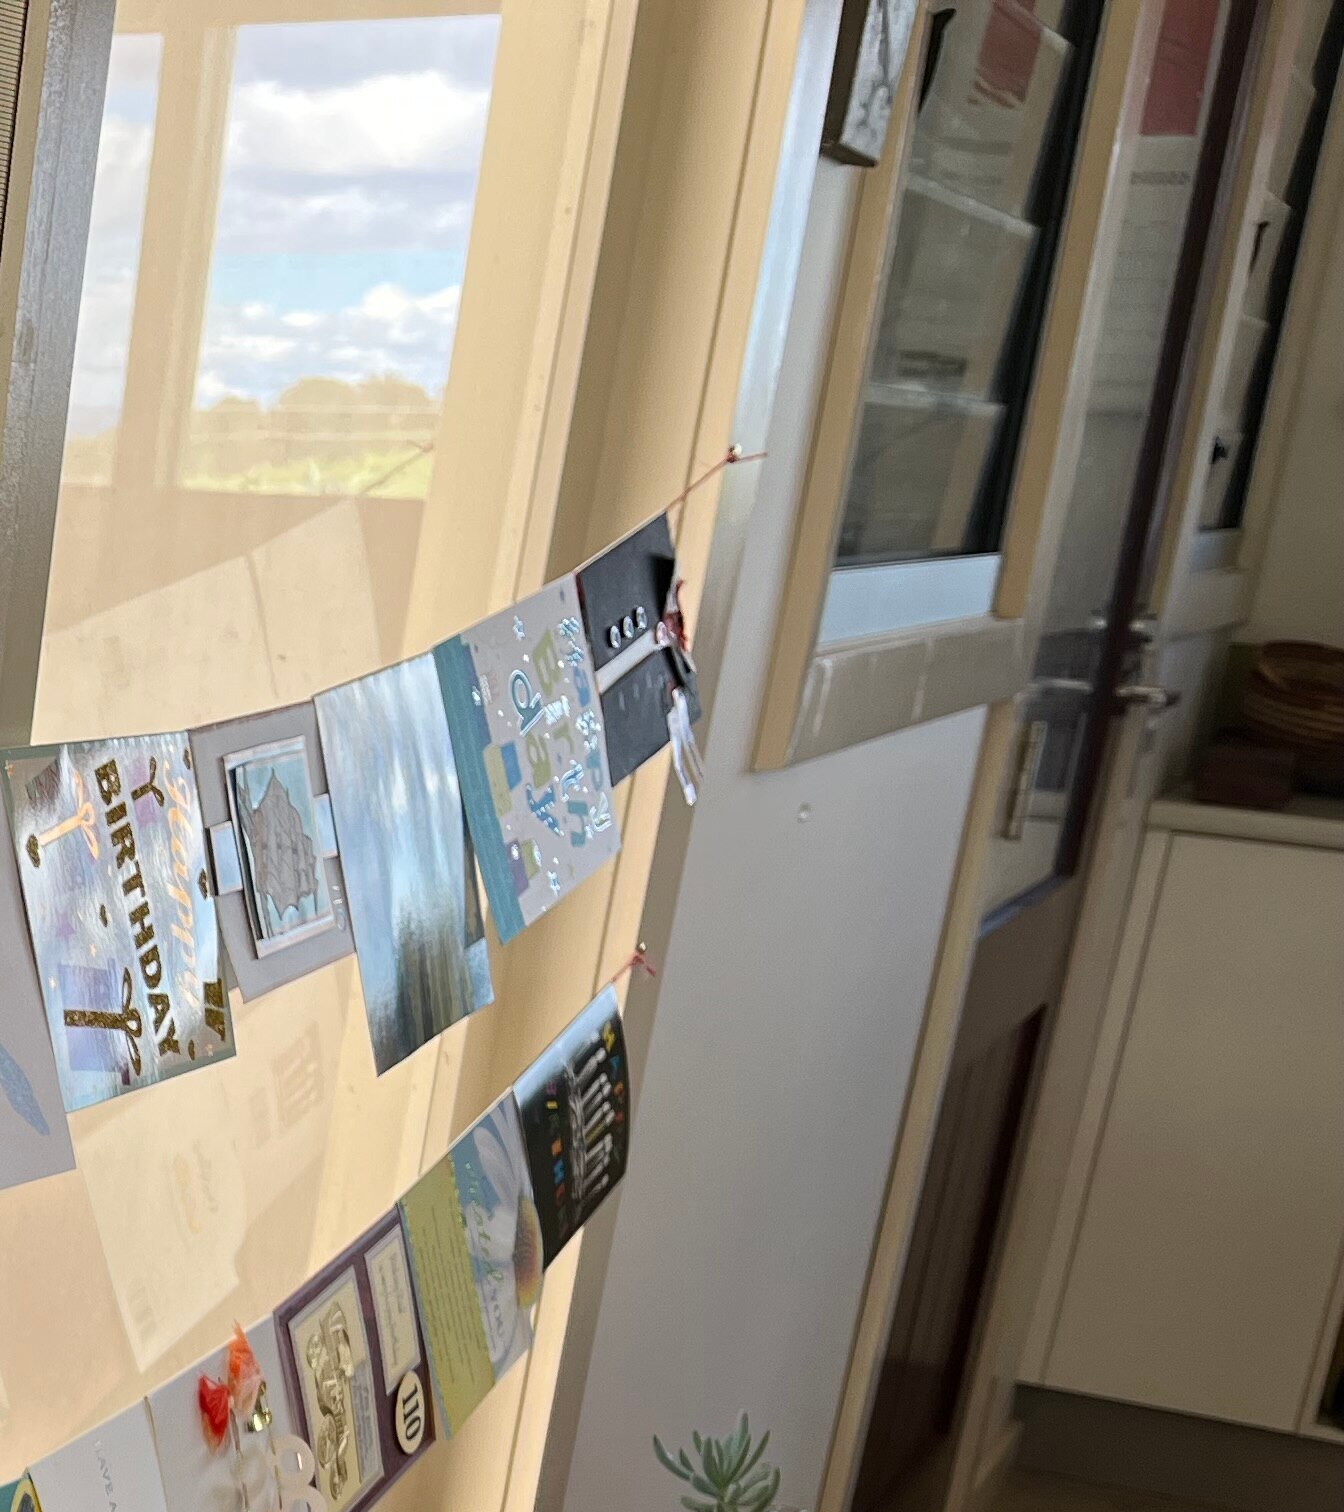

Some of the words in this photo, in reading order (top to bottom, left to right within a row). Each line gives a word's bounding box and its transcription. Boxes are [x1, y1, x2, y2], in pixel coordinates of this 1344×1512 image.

[95, 758, 180, 1057] BIRTHDAY
[163, 760, 200, 1008] Happy
[402, 1383, 421, 1441] 110
